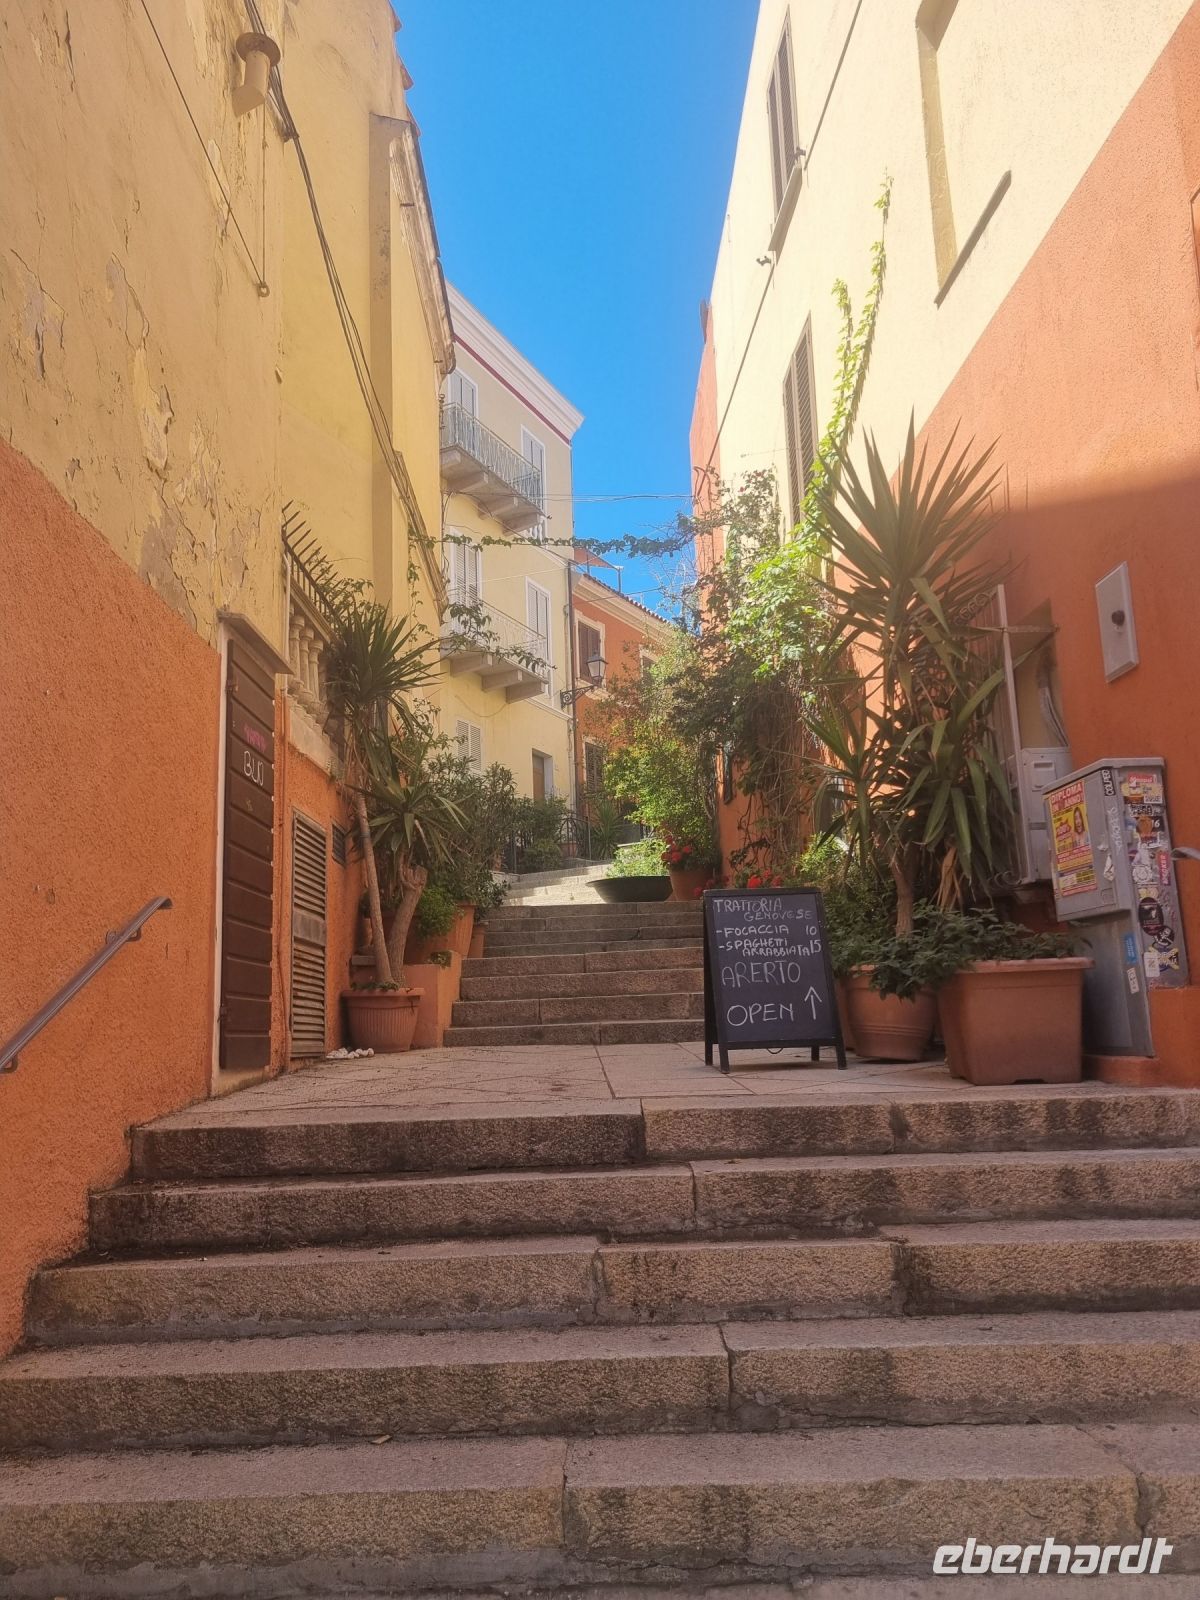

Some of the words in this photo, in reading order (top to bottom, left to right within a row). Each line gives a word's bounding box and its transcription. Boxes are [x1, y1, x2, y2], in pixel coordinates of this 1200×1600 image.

[1051, 782, 1082, 804] DIPLOMA
[713, 898, 782, 913] TRATTORIA
[743, 909, 813, 922] GENOVESE
[805, 925, 817, 936] 10
[742, 944, 811, 958] ARRABBIATA
[810, 939, 822, 954] 15
[726, 1003, 794, 1027] OPEN
